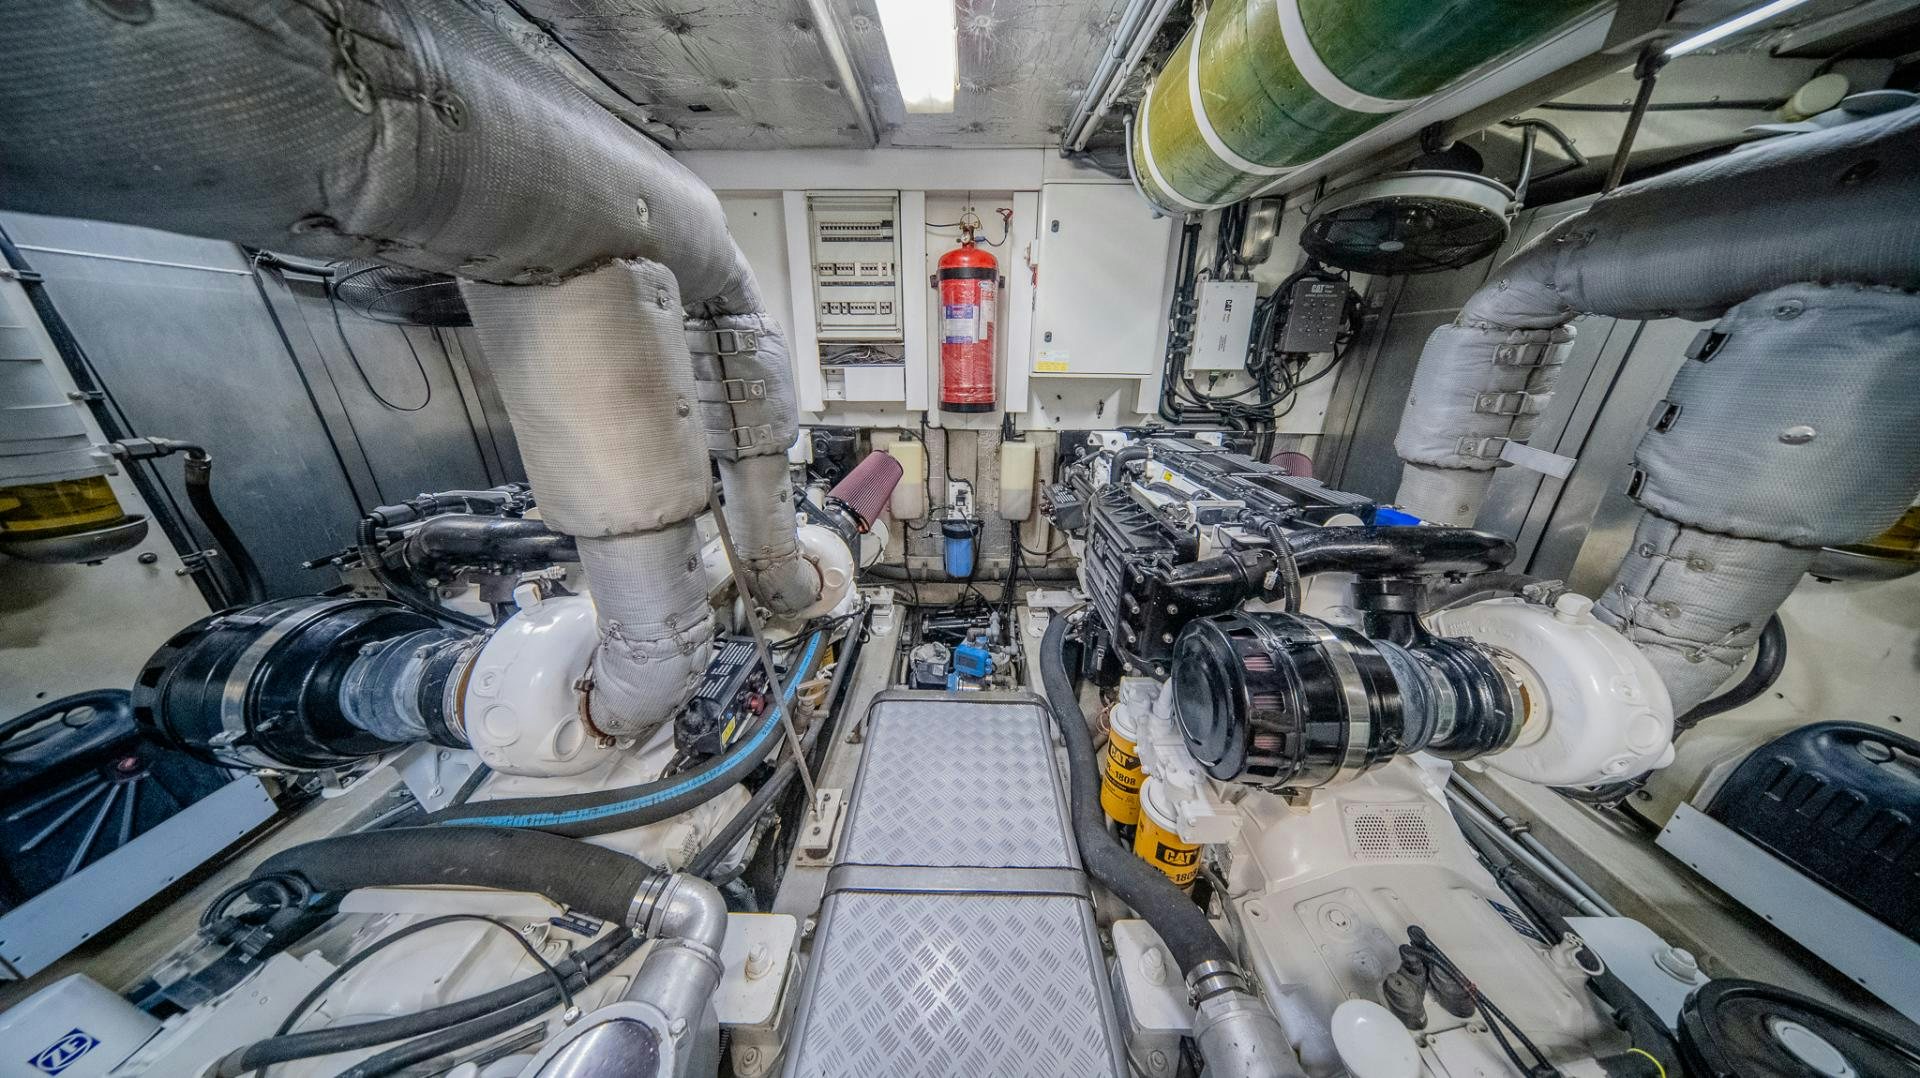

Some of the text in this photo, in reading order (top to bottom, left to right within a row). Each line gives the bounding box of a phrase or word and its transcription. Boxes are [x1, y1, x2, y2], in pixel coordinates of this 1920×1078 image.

[1311, 284, 1325, 293] CAT
[1224, 299, 1233, 312] CAT
[1110, 744, 1127, 767] CAT
[1163, 848, 1193, 865] CAT
